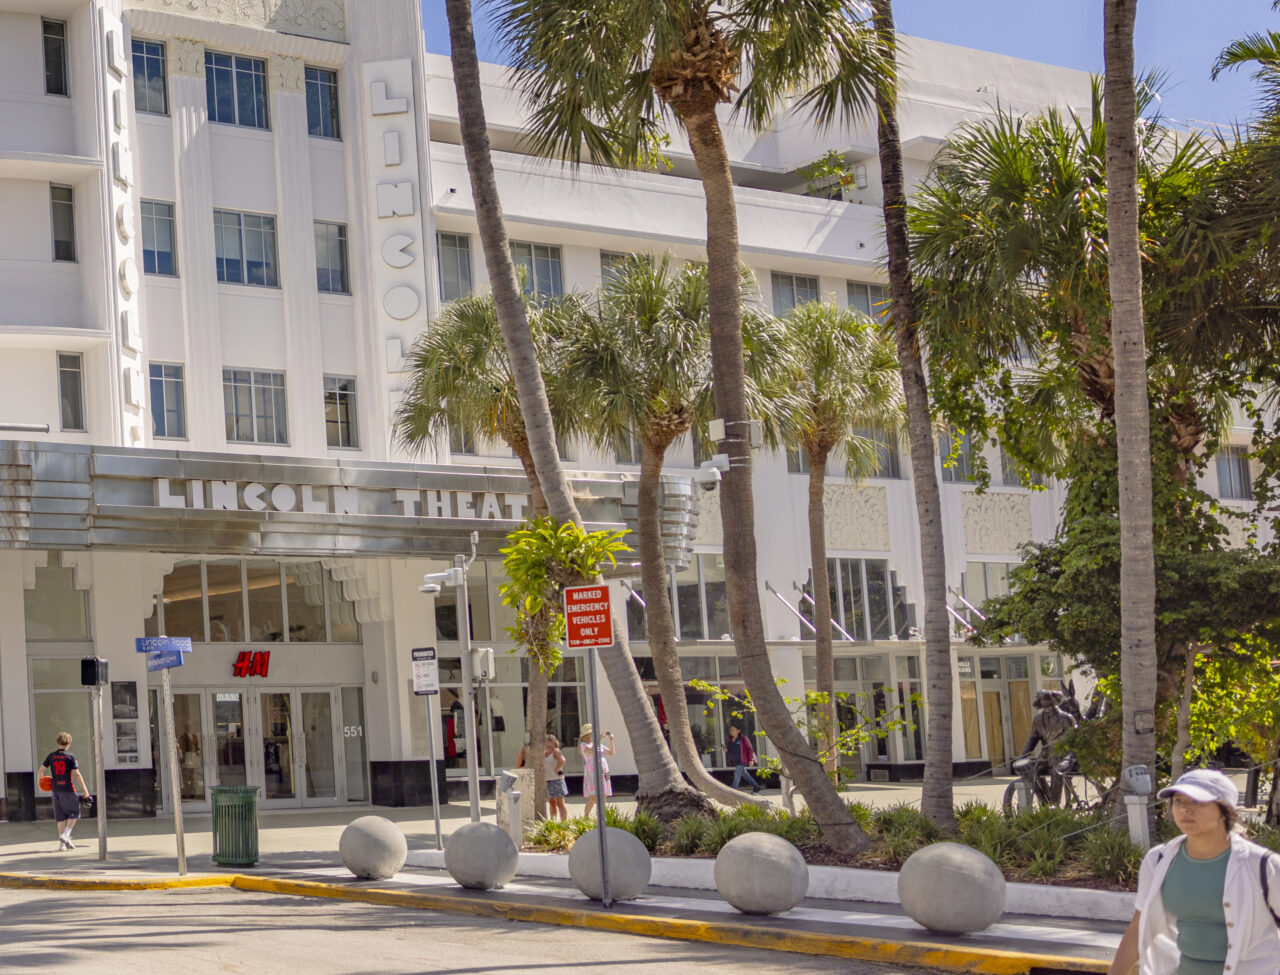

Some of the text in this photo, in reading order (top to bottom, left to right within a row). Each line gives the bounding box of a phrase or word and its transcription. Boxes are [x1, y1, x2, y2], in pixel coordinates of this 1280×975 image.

[107, 29, 146, 410] LINCOLN
[157, 477, 529, 521] LINCOLN THEAT
[572, 590, 602, 600] MARKED
[567, 602, 609, 613] EMERGENCY
[572, 614, 606, 624] VEHICLES
[580, 627, 599, 636] ONLY
[232, 650, 271, 678] H&M
[343, 725, 363, 737] 551
[53, 760, 66, 776] 19
